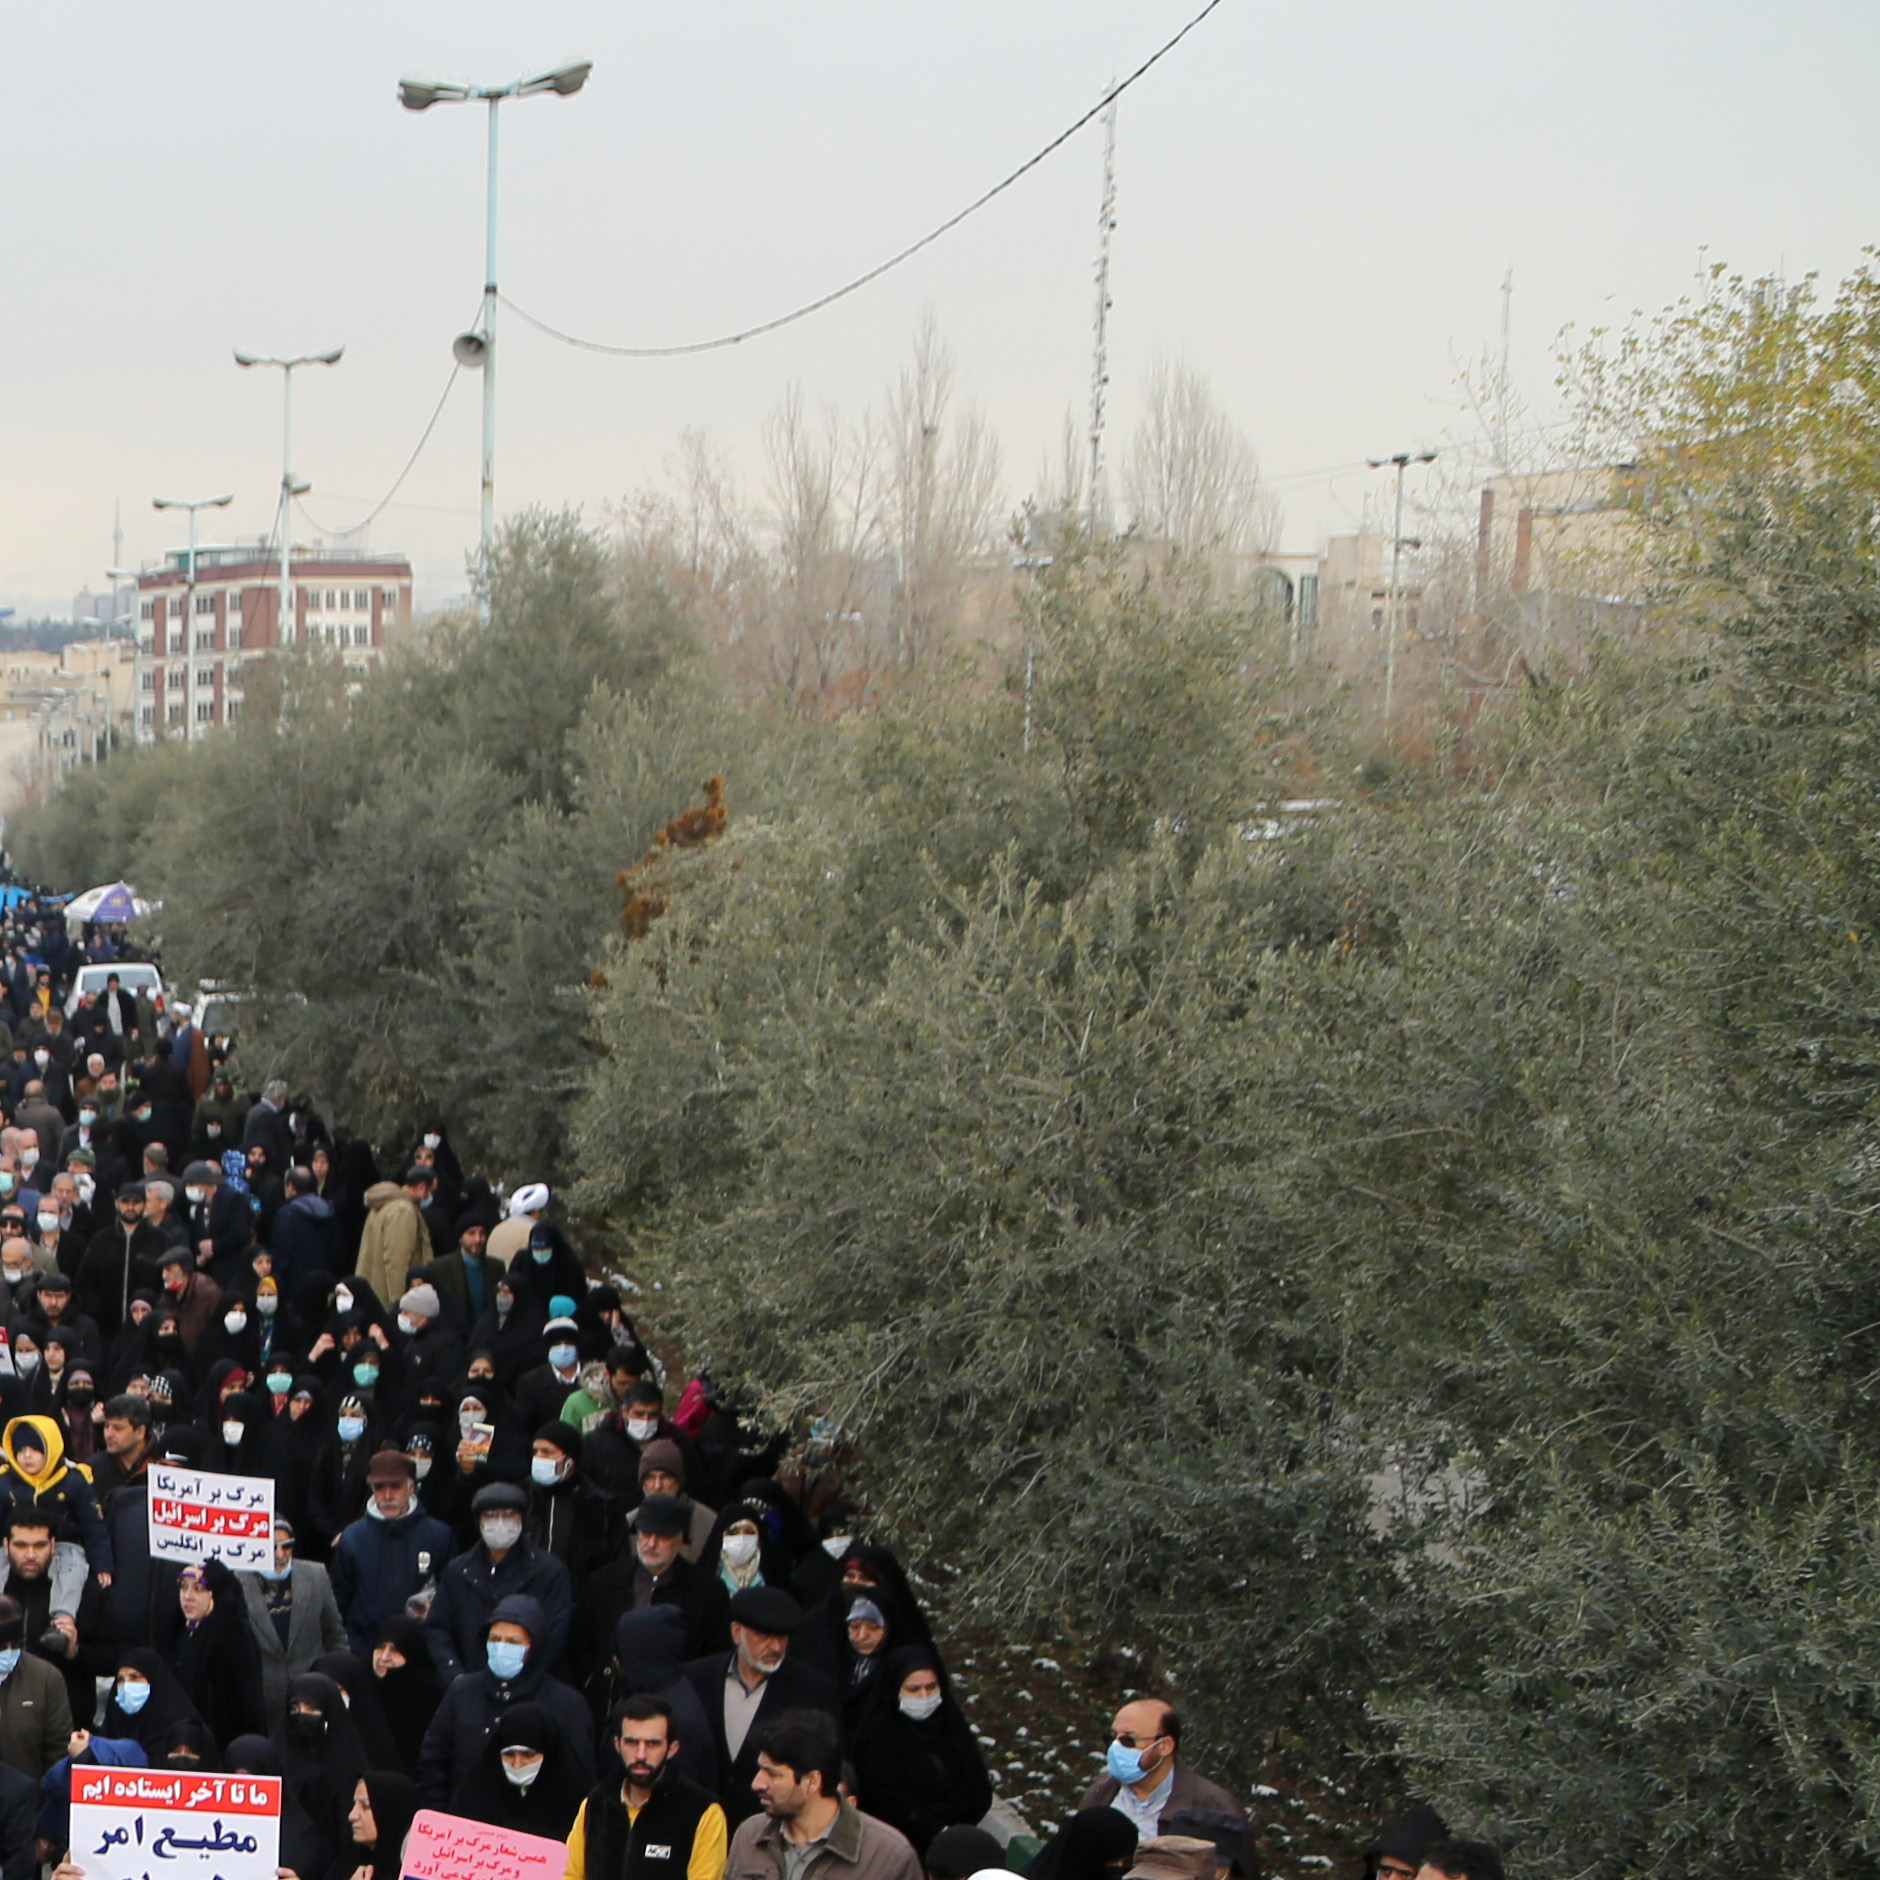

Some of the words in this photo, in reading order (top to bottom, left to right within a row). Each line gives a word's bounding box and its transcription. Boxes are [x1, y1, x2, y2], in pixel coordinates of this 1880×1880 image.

[82, 1775, 111, 1801] ایم
[114, 1776, 182, 1806] ایستاده
[185, 1780, 226, 1808] آخر
[230, 1782, 245, 1805] تا
[250, 1783, 269, 1806] ما
[92, 1813, 144, 1855] امر
[152, 1818, 258, 1859] مطیع
